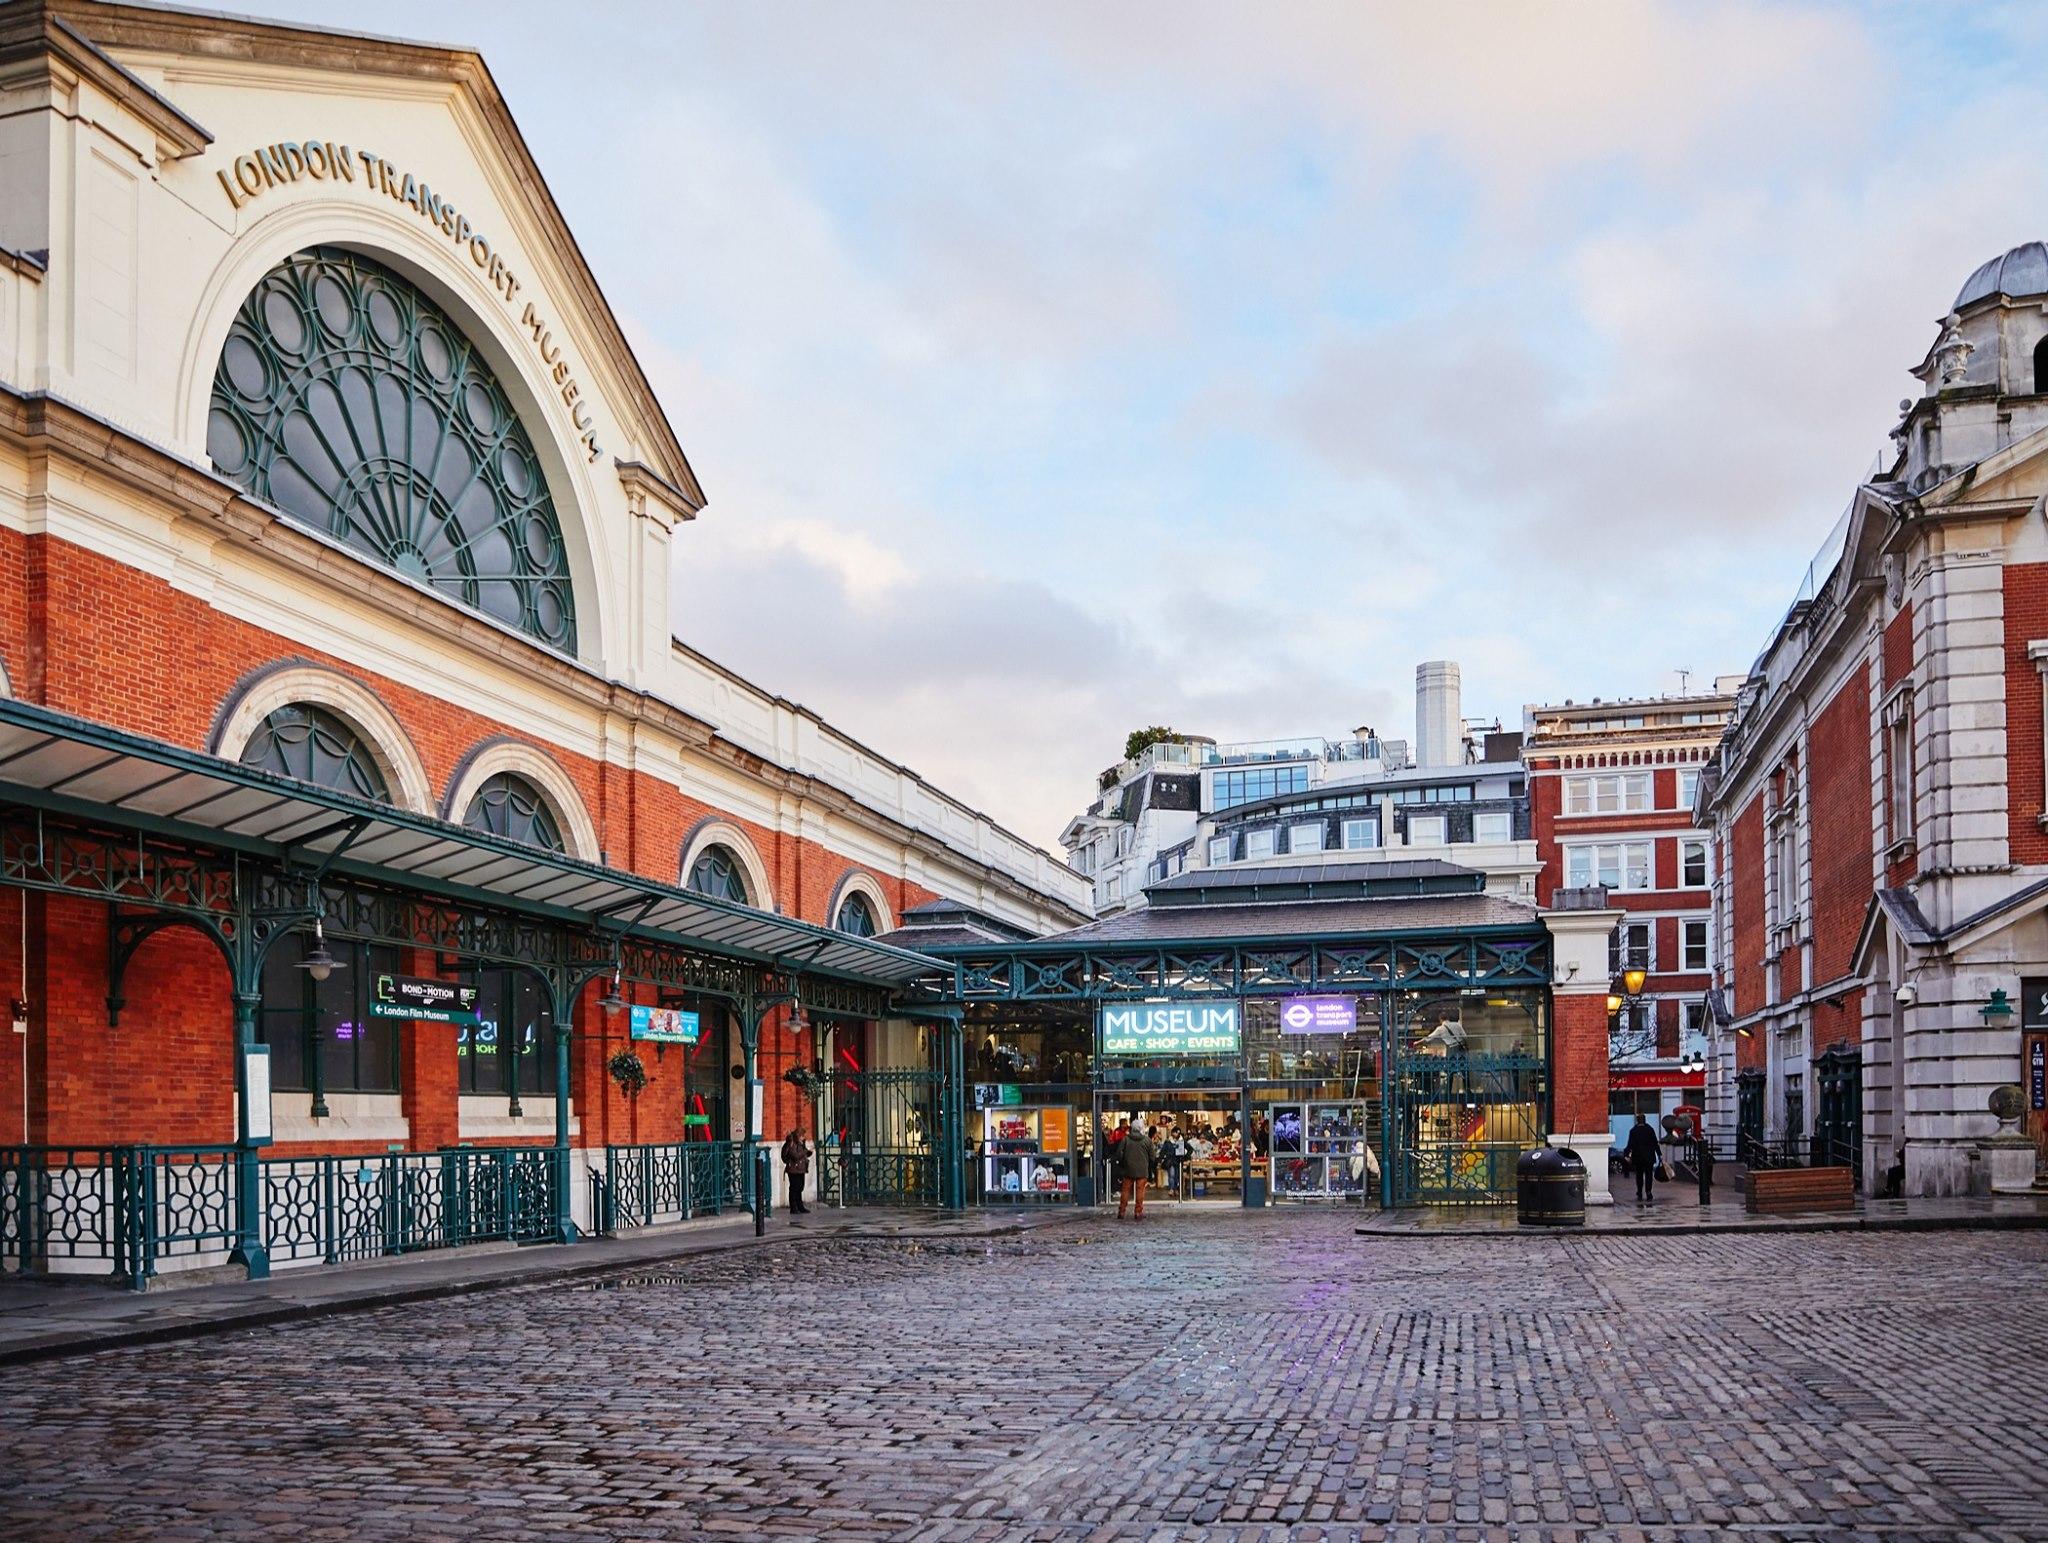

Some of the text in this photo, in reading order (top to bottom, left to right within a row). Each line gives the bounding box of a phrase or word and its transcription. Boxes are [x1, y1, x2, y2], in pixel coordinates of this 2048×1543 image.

[216, 140, 603, 464] LONDON TRANSPORT MUSEUM
[402, 983, 423, 995] BOND
[427, 987, 454, 998] MOTION
[384, 1006, 450, 1020] London Film Museum
[1105, 1008, 1235, 1035] MUSEUM
[1106, 1036, 1235, 1050] CAFE SHOP EVENTS
